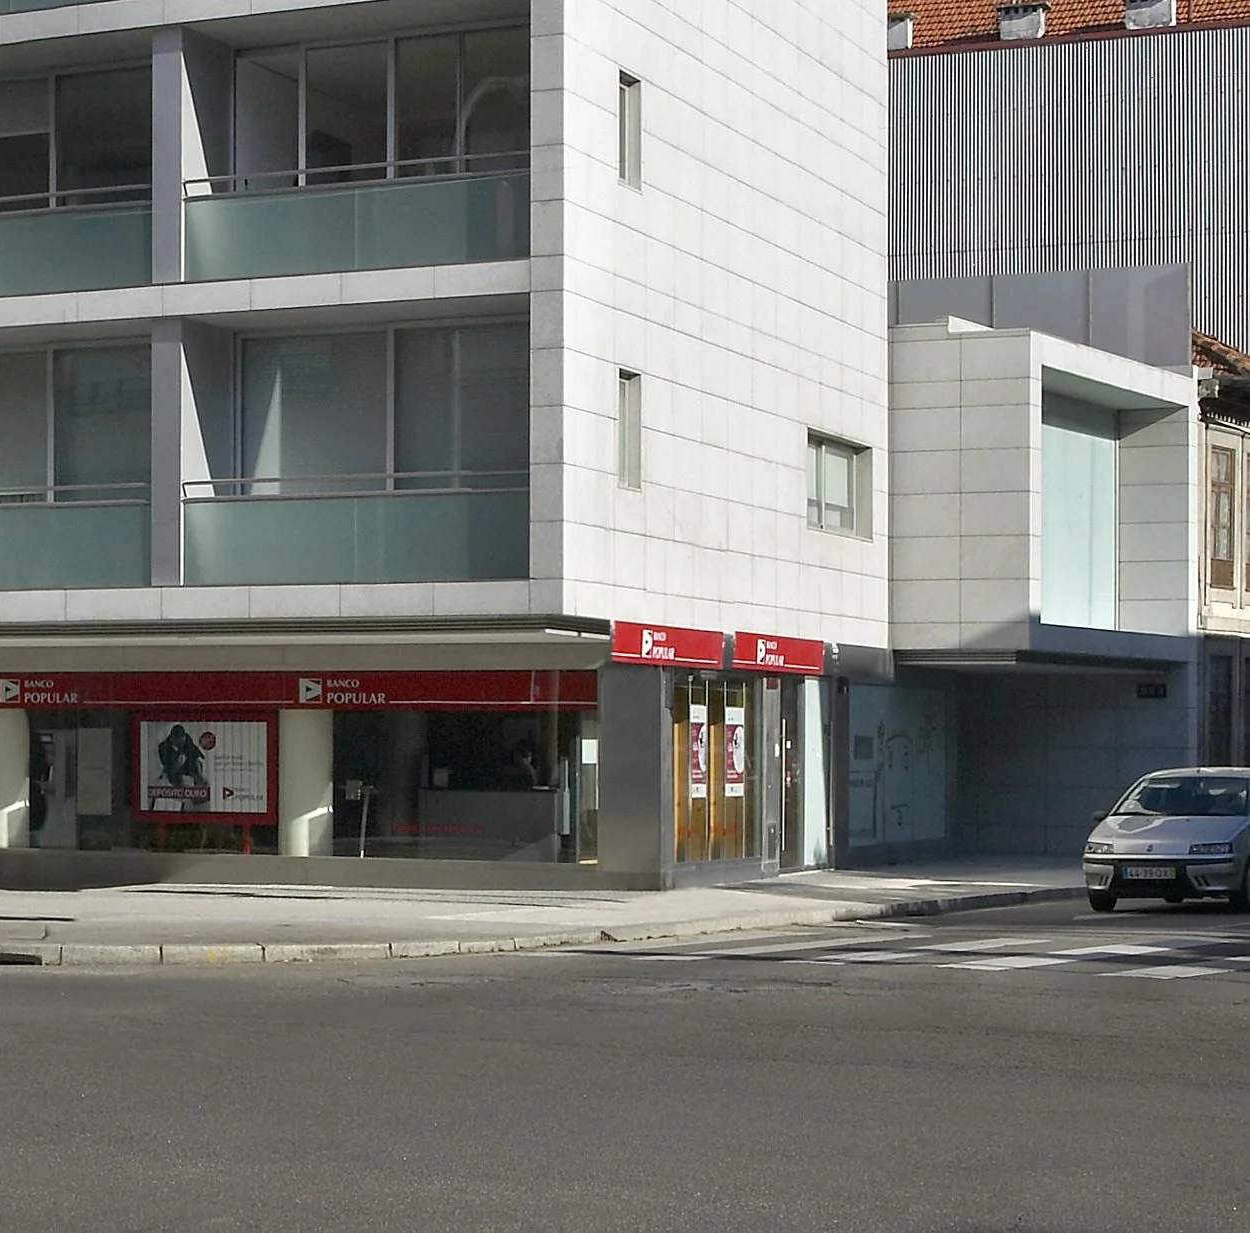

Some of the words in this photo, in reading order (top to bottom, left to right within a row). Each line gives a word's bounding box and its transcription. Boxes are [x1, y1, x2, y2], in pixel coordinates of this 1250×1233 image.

[23, 679, 54, 689] BANCO
[326, 679, 360, 689] BANCO
[23, 692, 79, 704] POPULAR
[326, 692, 386, 705] POPULAR
